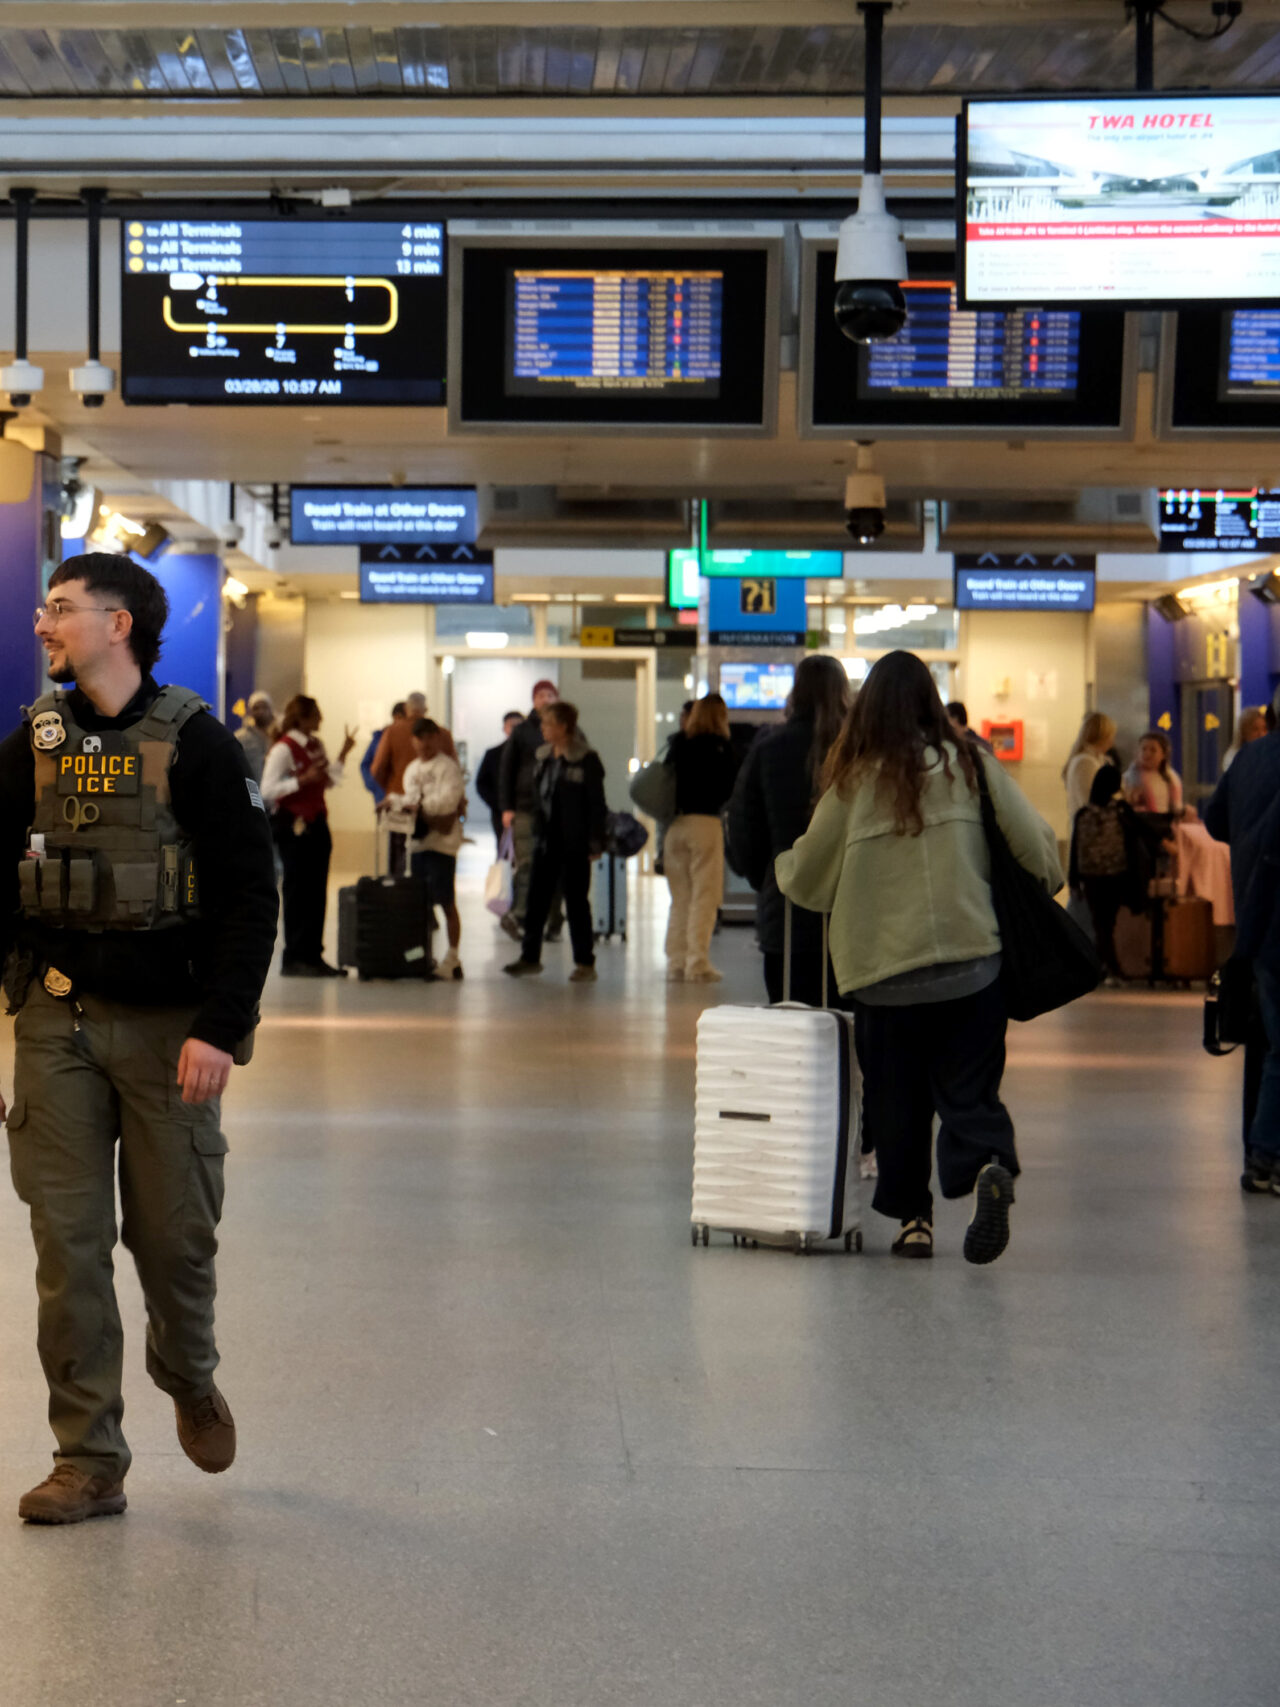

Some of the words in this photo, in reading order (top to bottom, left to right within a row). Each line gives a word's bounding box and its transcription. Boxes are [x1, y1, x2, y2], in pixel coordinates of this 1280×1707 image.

[1088, 114, 1135, 130] TWA
[1142, 112, 1214, 129] HOTEL
[160, 222, 179, 237] All
[180, 222, 242, 238] Terminals
[401, 223, 412, 239] 4
[413, 223, 440, 239] min
[160, 239, 179, 254] All
[180, 240, 242, 255] Terminals
[402, 241, 412, 257] 9
[413, 241, 440, 257] min
[160, 257, 179, 272] All
[180, 257, 242, 273] Terminals
[396, 258, 412, 275] 13
[413, 259, 440, 275] min
[206, 286, 217, 301] 4
[345, 287, 354, 302] 1
[275, 334, 286, 349] 7
[282, 380, 317, 394] 10:57
[318, 380, 341, 394] AM
[304, 502, 342, 517] Board
[343, 502, 374, 517] Train
[375, 503, 389, 517] at
[390, 502, 426, 517] Other
[428, 502, 466, 518] Doors
[311, 519, 336, 531] Train
[337, 519, 355, 531] will
[356, 519, 373, 531] not
[374, 519, 403, 531] board
[404, 519, 415, 531] at
[416, 519, 433, 531] this
[434, 519, 458, 532] door
[369, 571, 396, 584] Board
[397, 571, 419, 584] Train
[966, 578, 994, 590] Board
[995, 578, 1017, 590] Train
[1029, 578, 1056, 591] Other
[1057, 578, 1085, 592] Doors
[61, 756, 136, 775] POLICE
[77, 777, 116, 793] ICE
[187, 860, 195, 902] ICE
